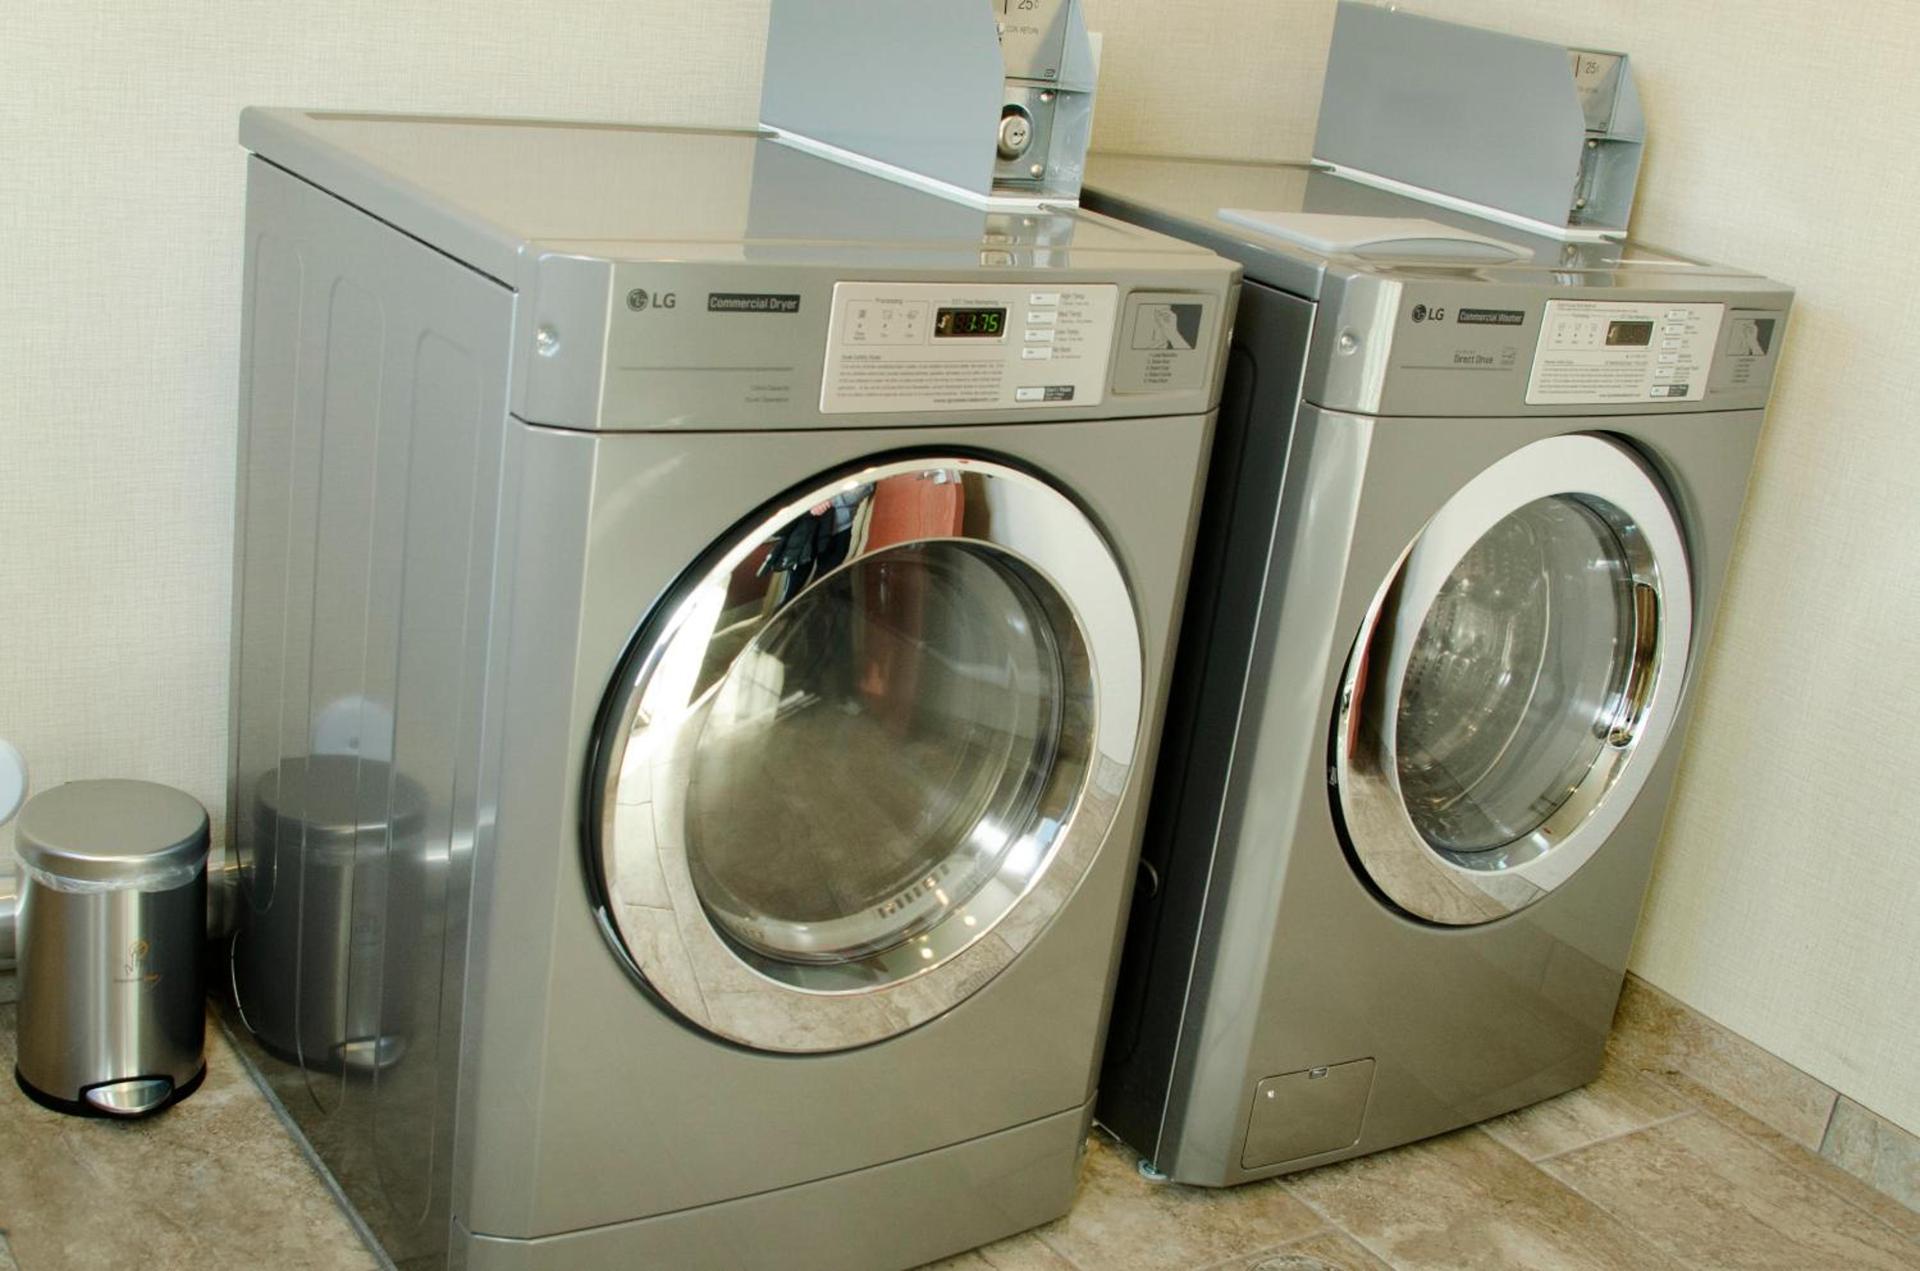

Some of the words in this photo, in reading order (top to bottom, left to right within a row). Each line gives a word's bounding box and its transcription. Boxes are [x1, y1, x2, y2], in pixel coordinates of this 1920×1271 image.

[652, 292, 676, 309] LG
[709, 296, 768, 309] Commercial
[770, 298, 798, 311] Dryer
[1428, 307, 1445, 321] LG
